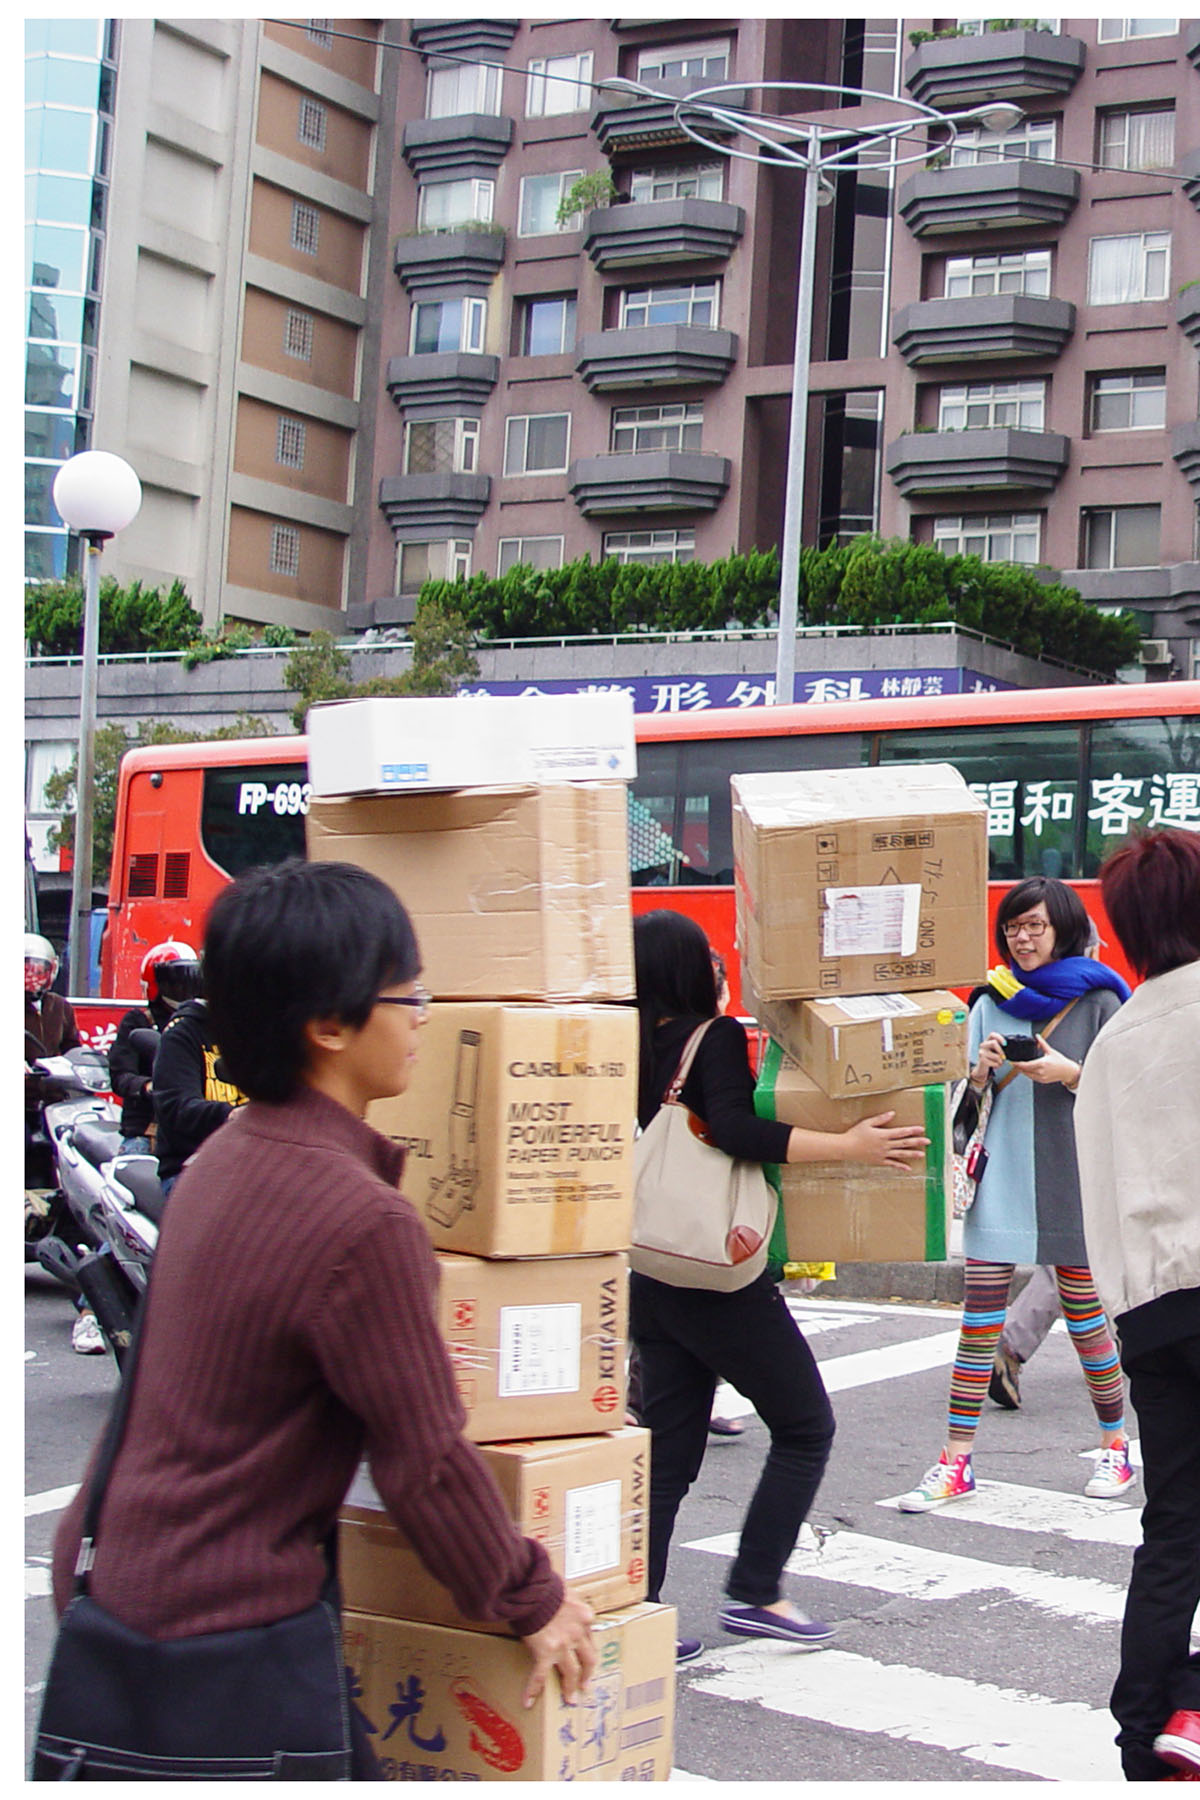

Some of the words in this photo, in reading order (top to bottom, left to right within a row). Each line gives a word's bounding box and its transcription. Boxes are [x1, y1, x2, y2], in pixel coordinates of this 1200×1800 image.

[508, 1061, 569, 1079] CARL
[507, 1102, 572, 1122] MOST
[506, 1123, 625, 1146] POWERFUL
[505, 1147, 560, 1164] PAPER
